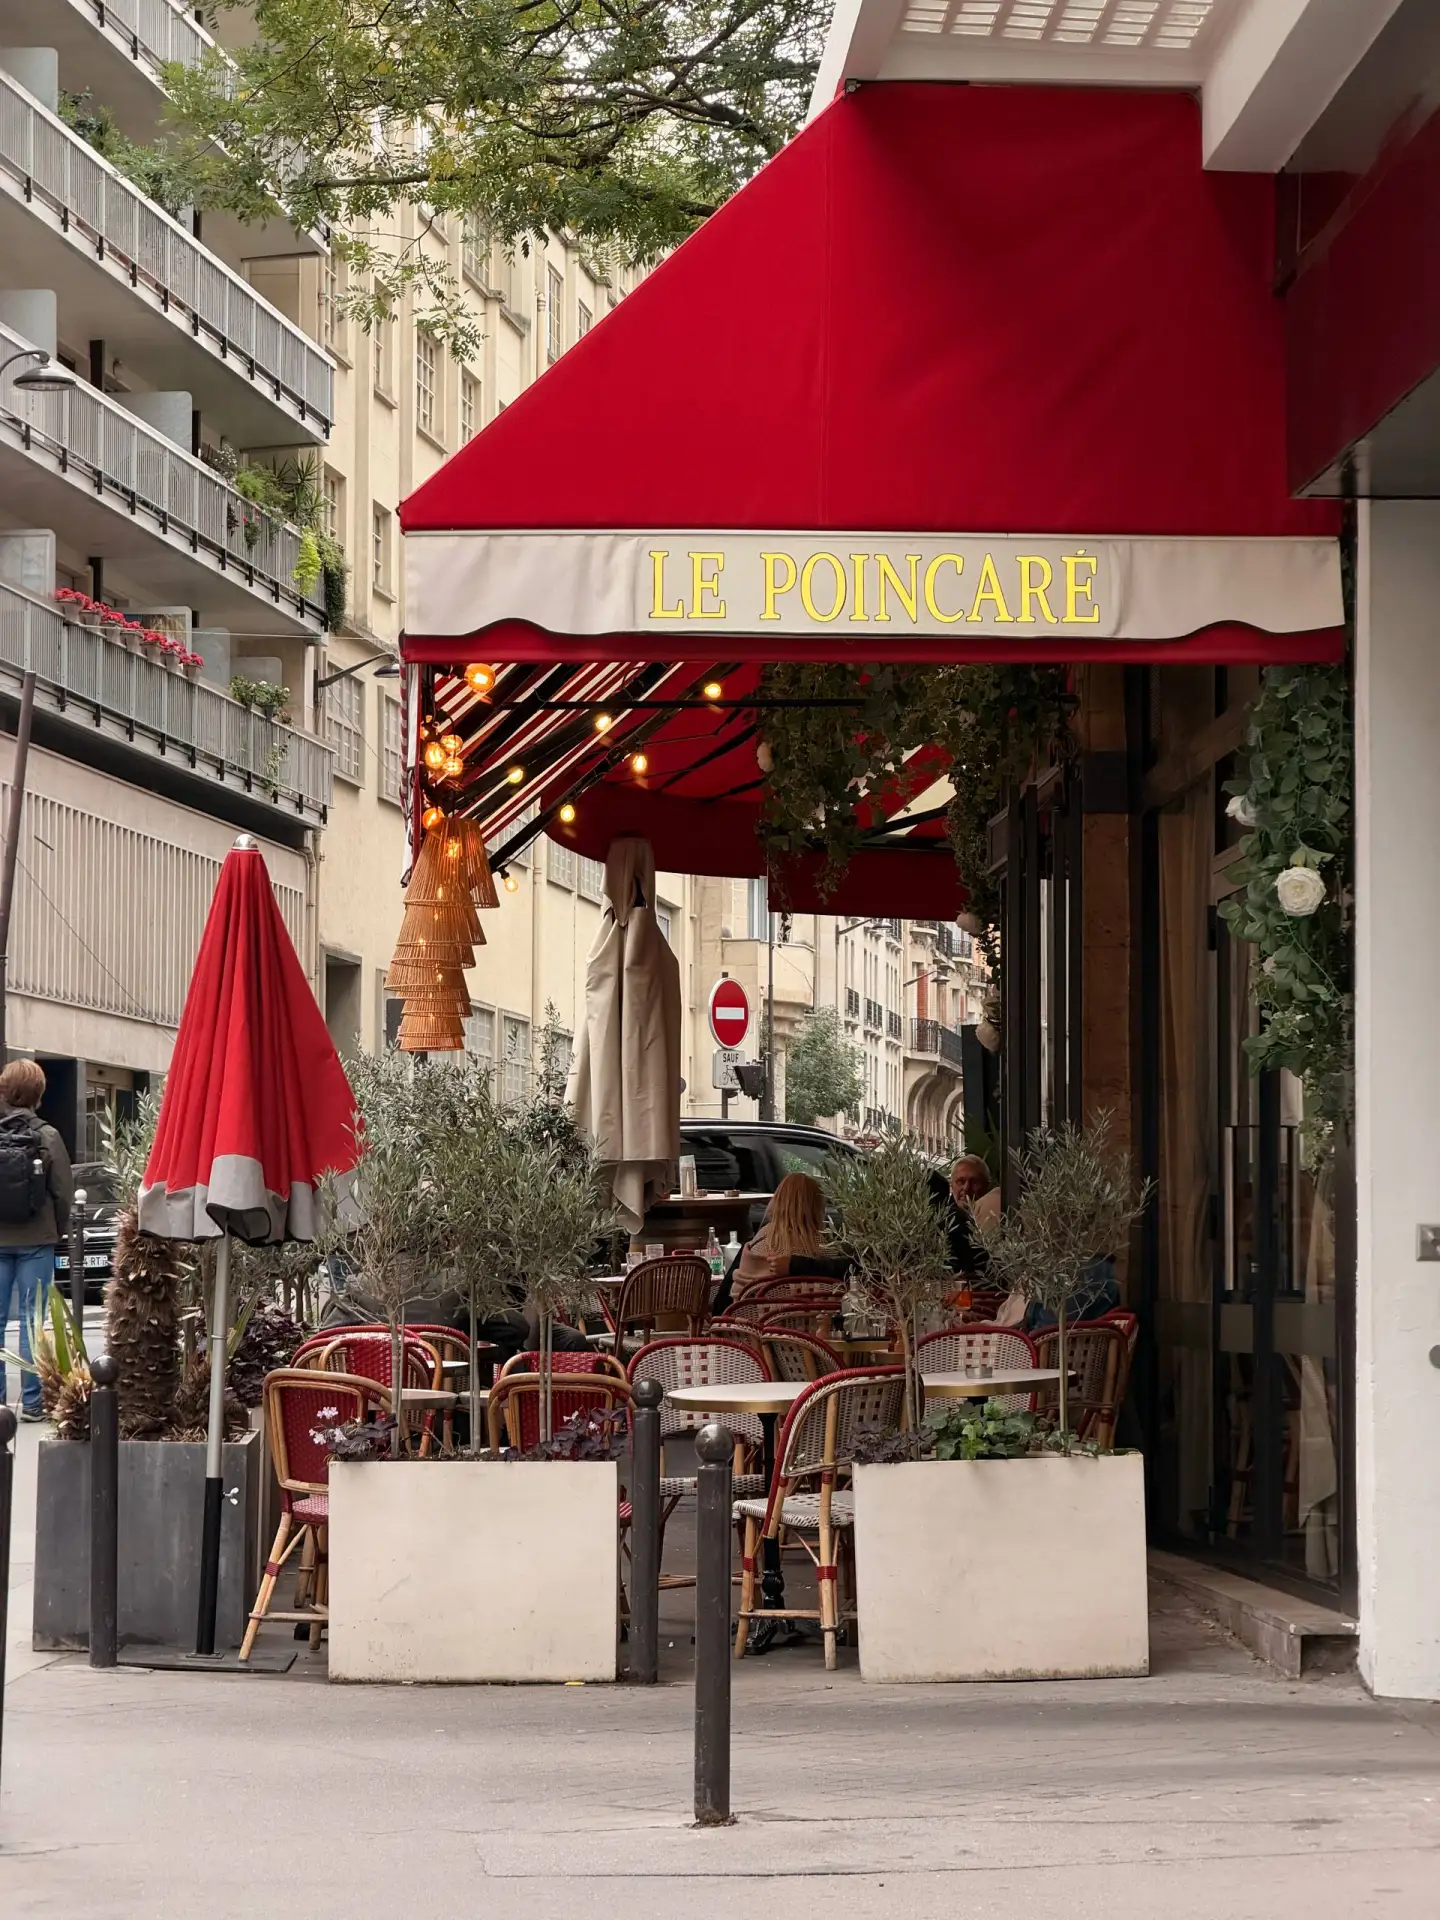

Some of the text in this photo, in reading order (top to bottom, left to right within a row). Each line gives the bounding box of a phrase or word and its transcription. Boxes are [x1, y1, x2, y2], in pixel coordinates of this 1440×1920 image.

[648, 549, 1101, 625] LE POINCARÉ
[722, 1052, 739, 1063] SAUF
